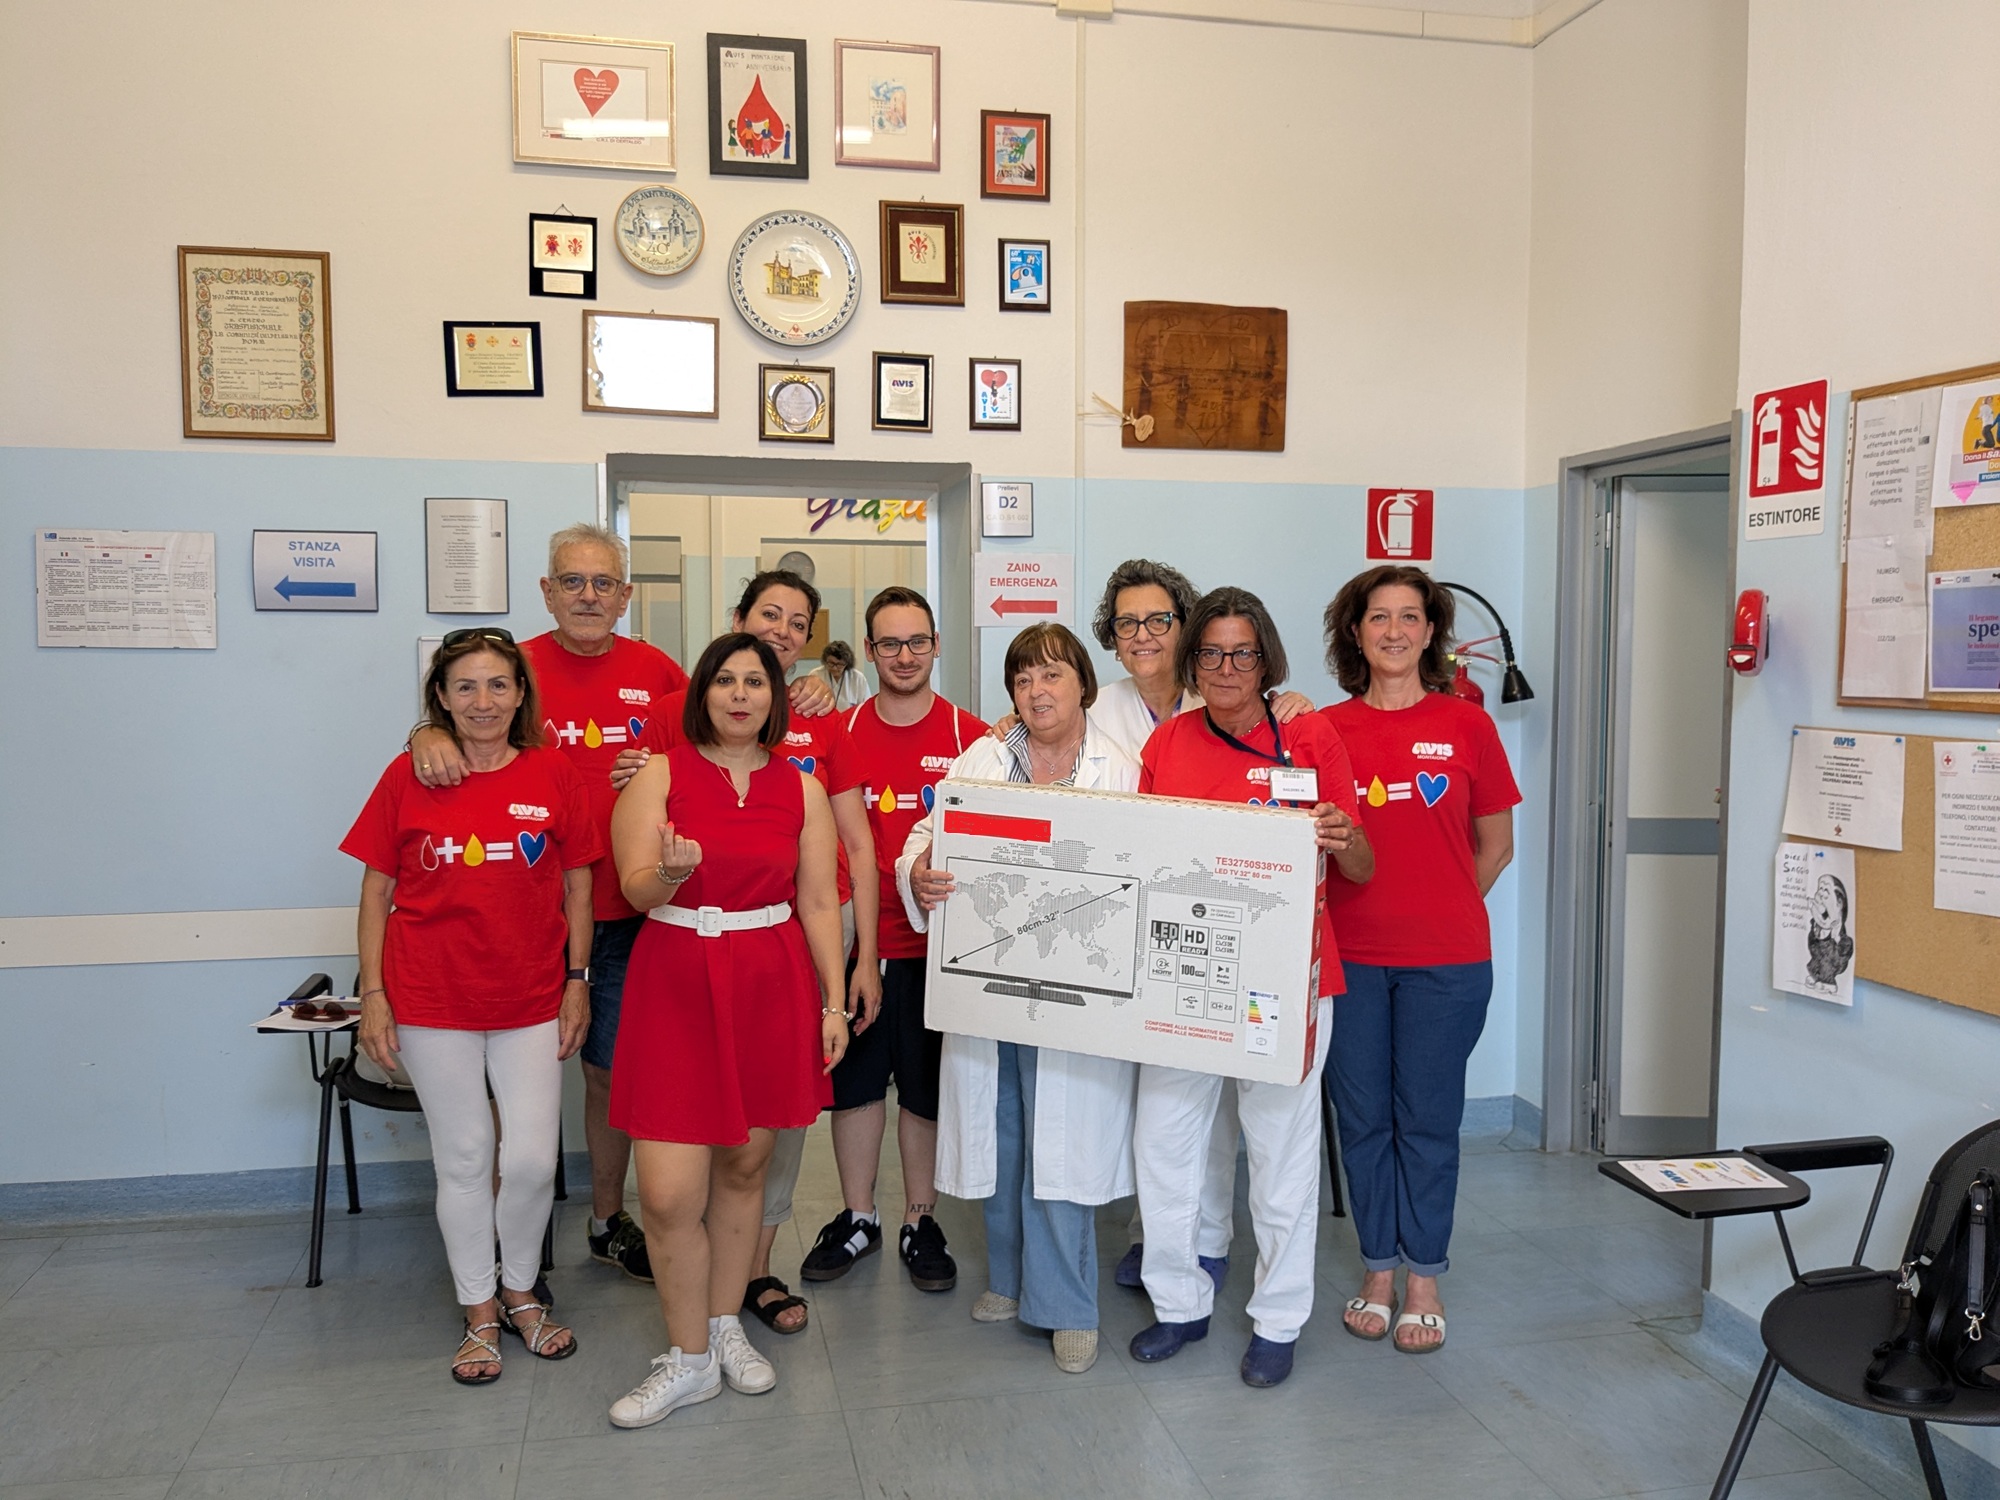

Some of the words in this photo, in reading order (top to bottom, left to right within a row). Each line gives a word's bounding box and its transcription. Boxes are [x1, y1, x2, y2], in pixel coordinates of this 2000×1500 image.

[891, 379, 915, 388] AVIS
[1964, 453, 1982, 462] Dona
[999, 496, 1018, 509] D2
[1749, 506, 1821, 528] ESTINTORE
[288, 541, 341, 552] STANZA
[293, 557, 336, 568] VISITA
[1006, 562, 1041, 573] ZAINO
[1877, 567, 1900, 575] NUMERO
[989, 577, 1058, 588] EMERGENZA
[1871, 595, 1904, 604] EMERGENZA
[1975, 613, 1999, 624] legame
[1968, 622, 2000, 642] spe
[618, 688, 651, 703] AVIS
[1833, 736, 1856, 748] AVIS
[1411, 742, 1453, 757] AVIS
[509, 803, 550, 818] AVIS
[1971, 815, 1996, 823] DONATORI
[1215, 856, 1293, 873] TE32750S38YXD
[1016, 910, 1060, 935] 80cm-32"
[1152, 921, 1178, 940] LED
[1184, 929, 1205, 944] HD
[1155, 938, 1174, 950] TV
[1182, 947, 1206, 955] READY
[1181, 964, 1195, 976] 100
[1144, 1020, 1173, 1028] CONFORME
[1188, 1026, 1218, 1035] NORMATIVE
[1144, 1025, 1173, 1034] CONFORME
[1188, 1032, 1217, 1041] NORMATIVE
